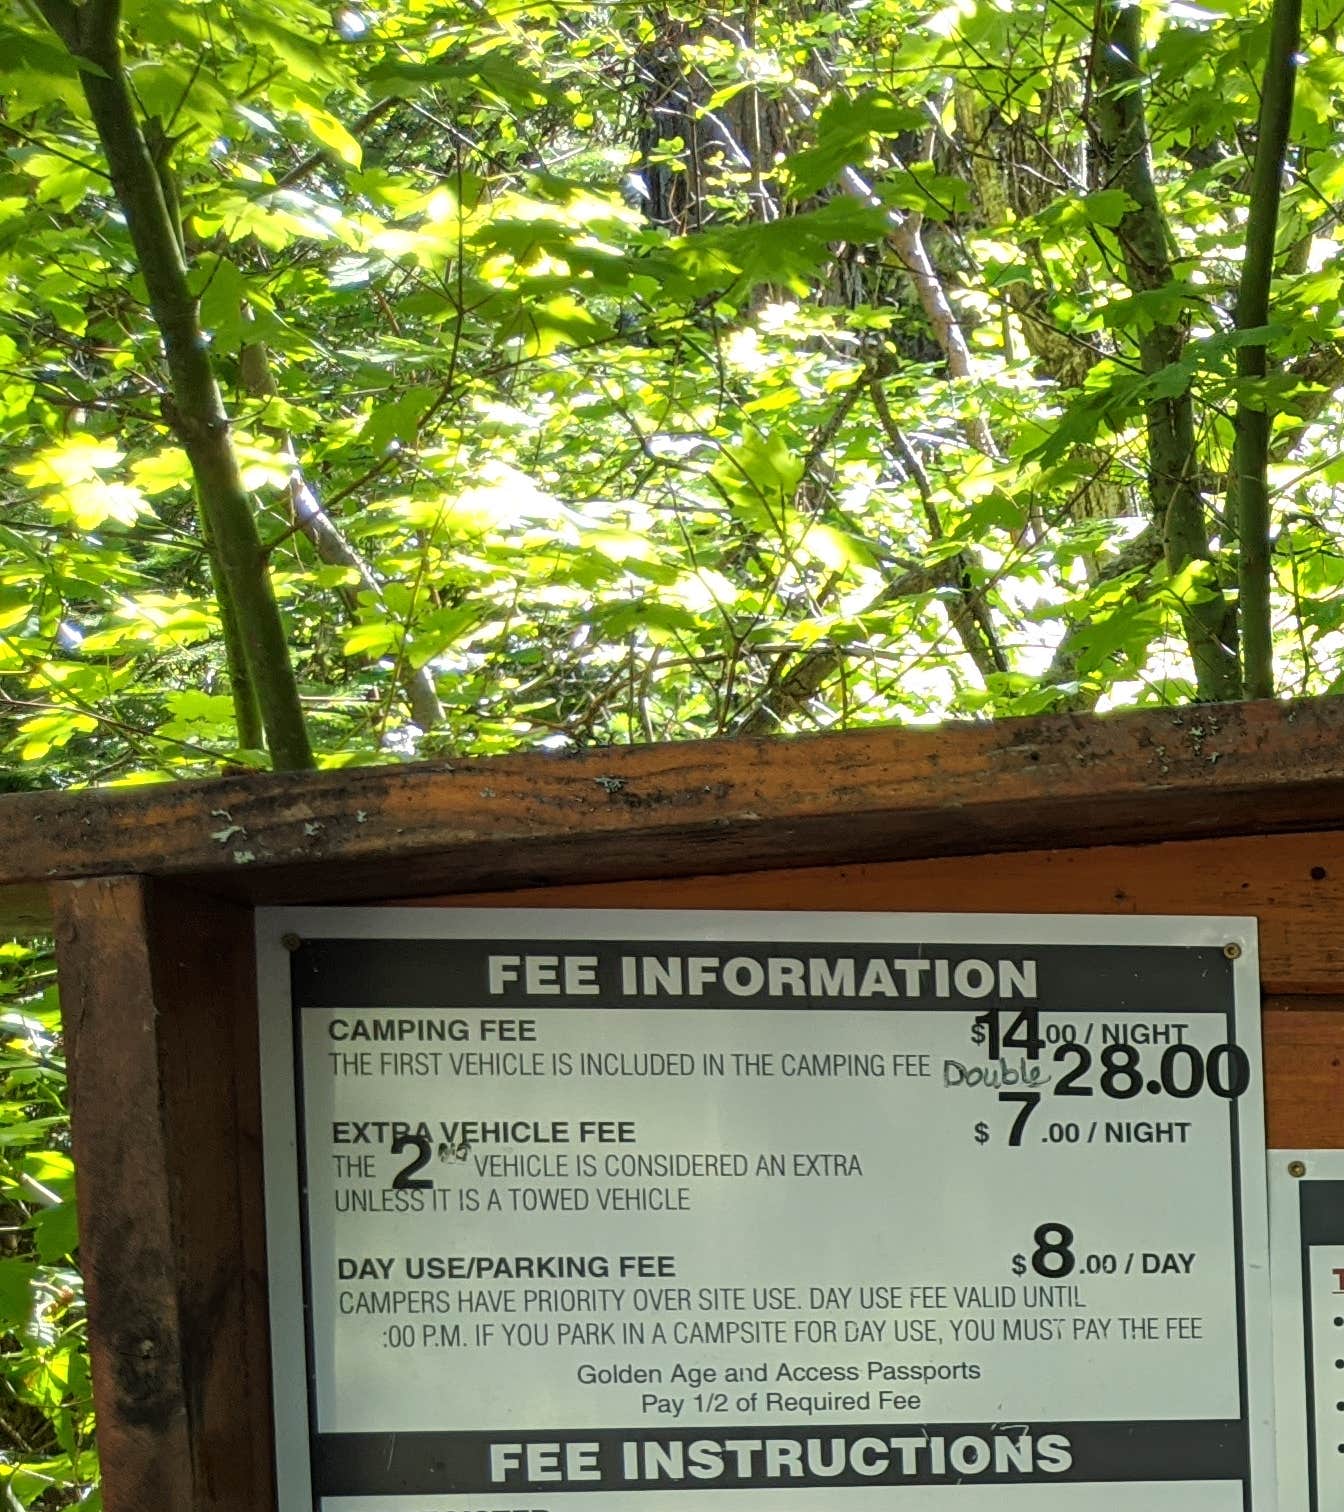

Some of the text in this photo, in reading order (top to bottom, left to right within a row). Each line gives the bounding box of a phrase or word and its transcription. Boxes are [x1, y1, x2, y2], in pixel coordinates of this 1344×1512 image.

[489, 956, 1036, 998] FEE INFORMATION
[329, 1019, 536, 1041] CAMPING FEE
[1052, 1044, 1251, 1098] 28.00
[338, 1256, 675, 1279] DAY USE/PARKING FEE
[578, 1362, 980, 1388] Golden Age and Access Passports
[491, 1435, 1072, 1482] FEE INSTRUCTIONS
